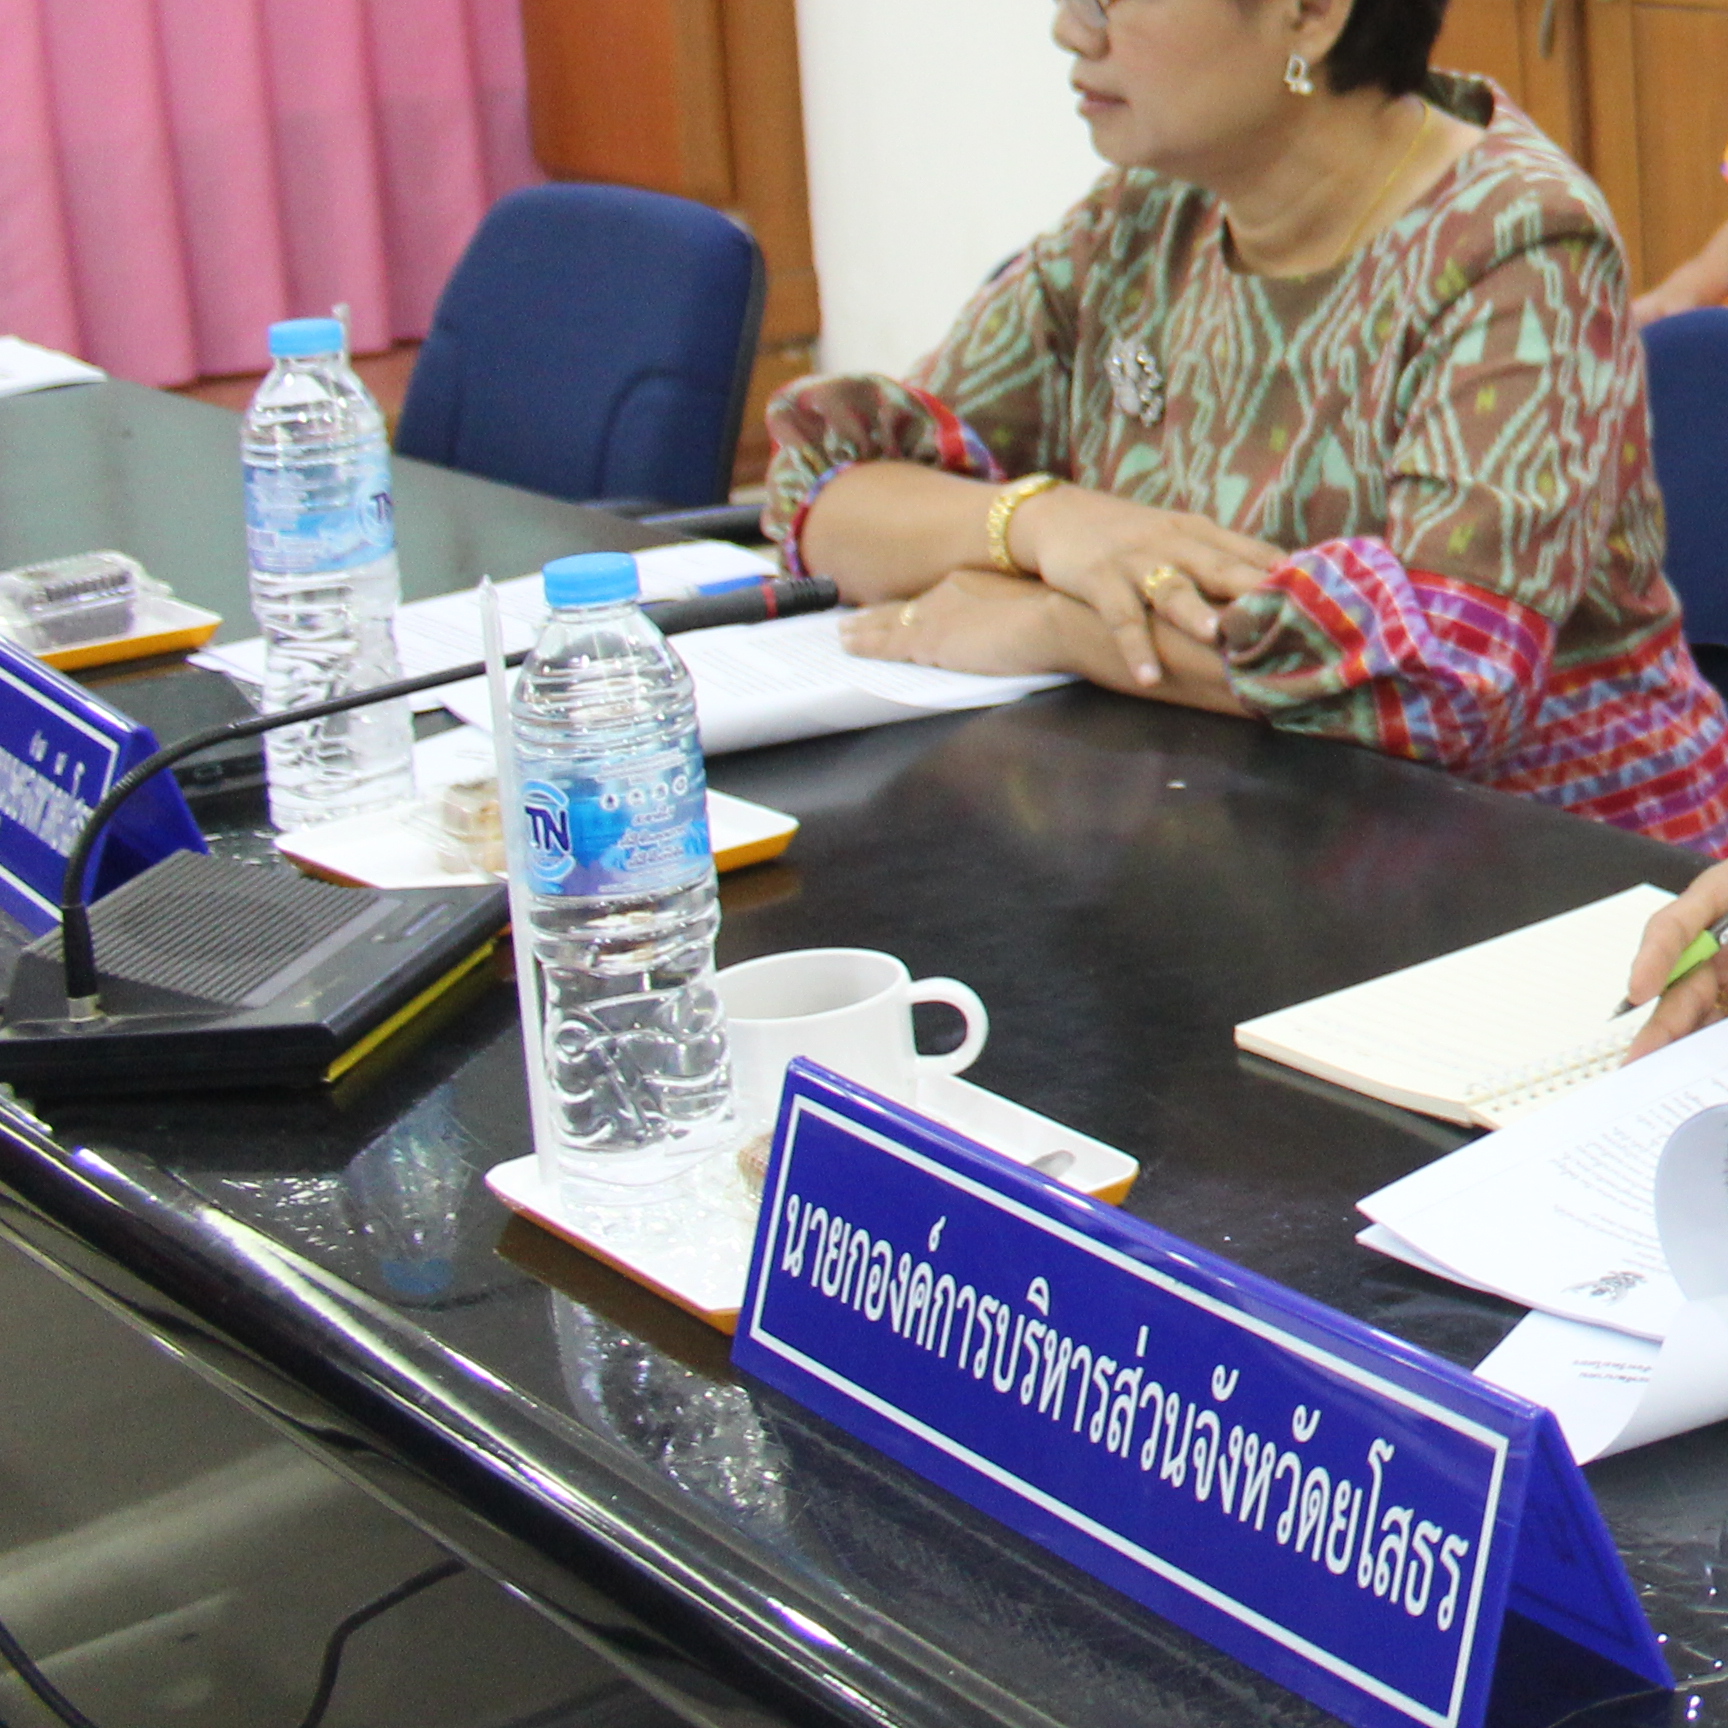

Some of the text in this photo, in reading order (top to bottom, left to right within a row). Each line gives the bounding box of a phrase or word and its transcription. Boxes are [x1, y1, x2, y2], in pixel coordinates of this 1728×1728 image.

[524, 804, 571, 853] TN
[780, 1191, 1471, 1634] นายกองค์การบริหารส่วนจังหวัดยโสธร
